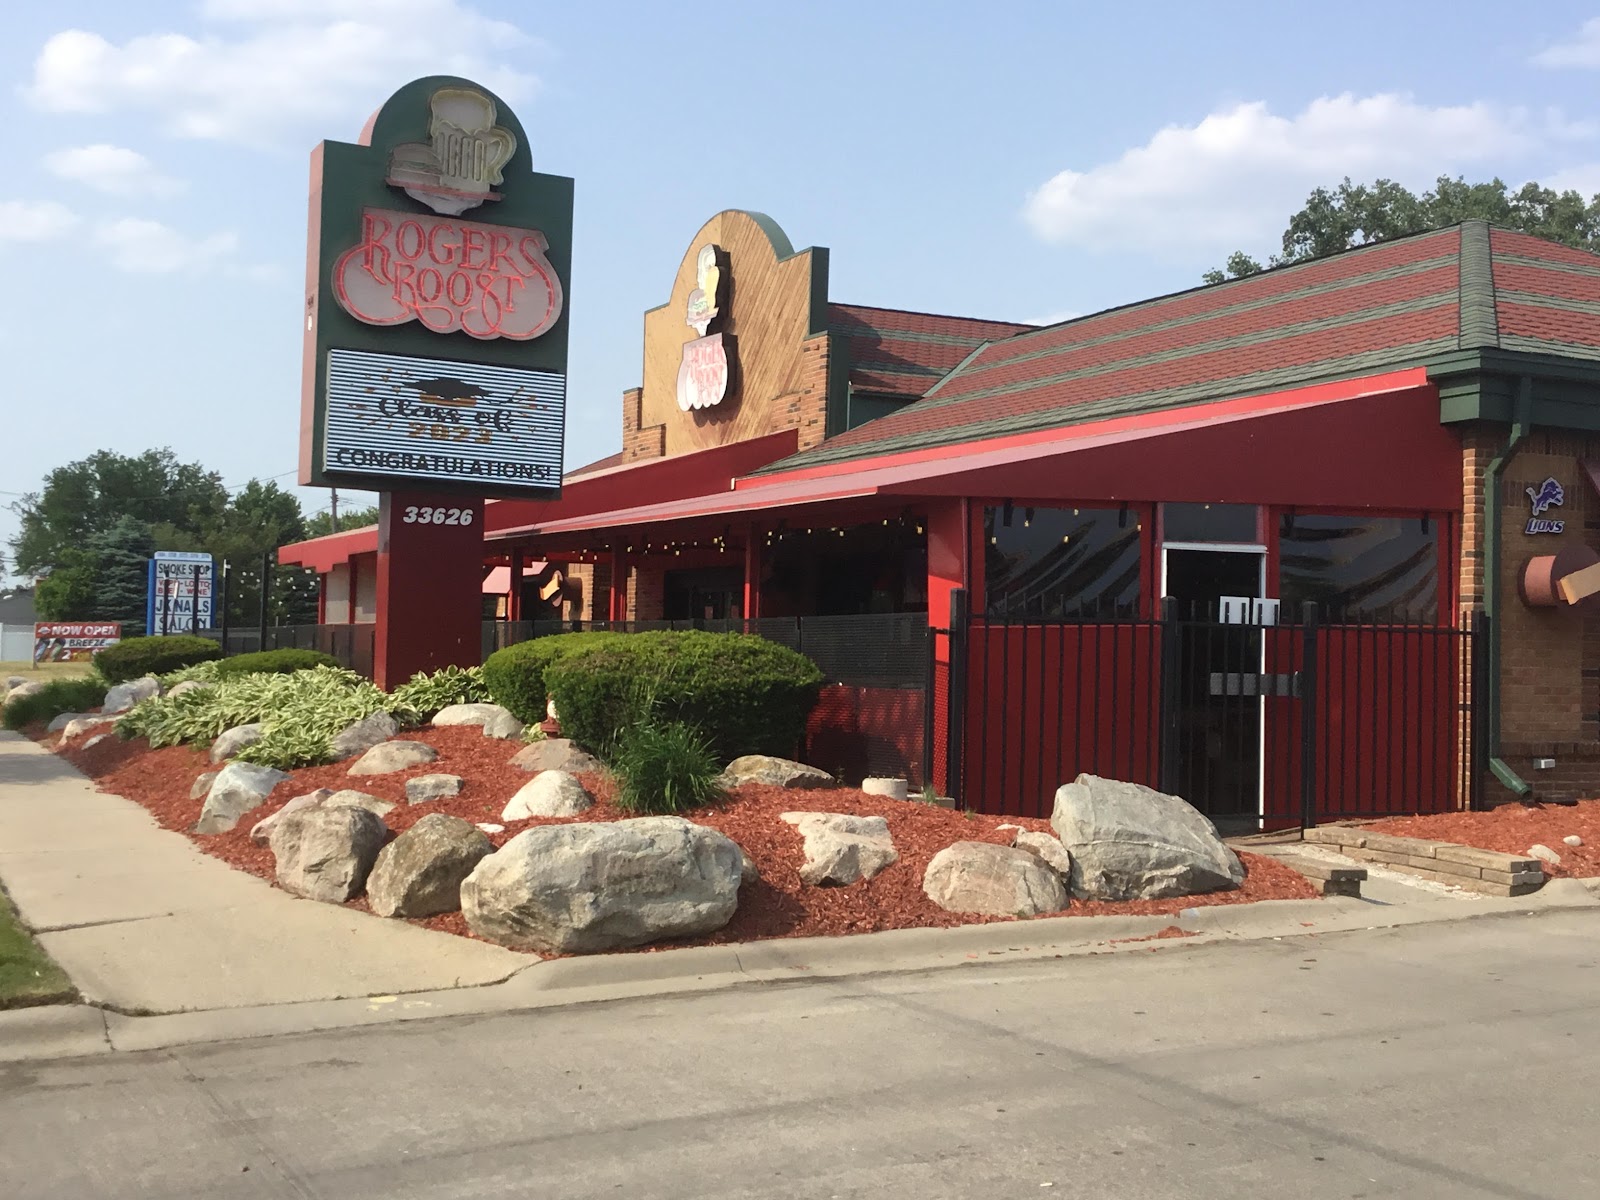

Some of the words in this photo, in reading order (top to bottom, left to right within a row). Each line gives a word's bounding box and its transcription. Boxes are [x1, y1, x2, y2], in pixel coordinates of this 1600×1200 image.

[348, 213, 548, 291] ROGERS
[391, 261, 528, 332] ROOST
[379, 397, 463, 425] Class
[337, 448, 551, 480] CONGRATULATIONS!
[403, 506, 474, 526] 33626
[158, 563, 186, 575] SMOKE
[188, 564, 210, 575] SOP
[185, 580, 210, 588] LOTO
[51, 625, 82, 635] NOW
[84, 626, 117, 636] OPEN
